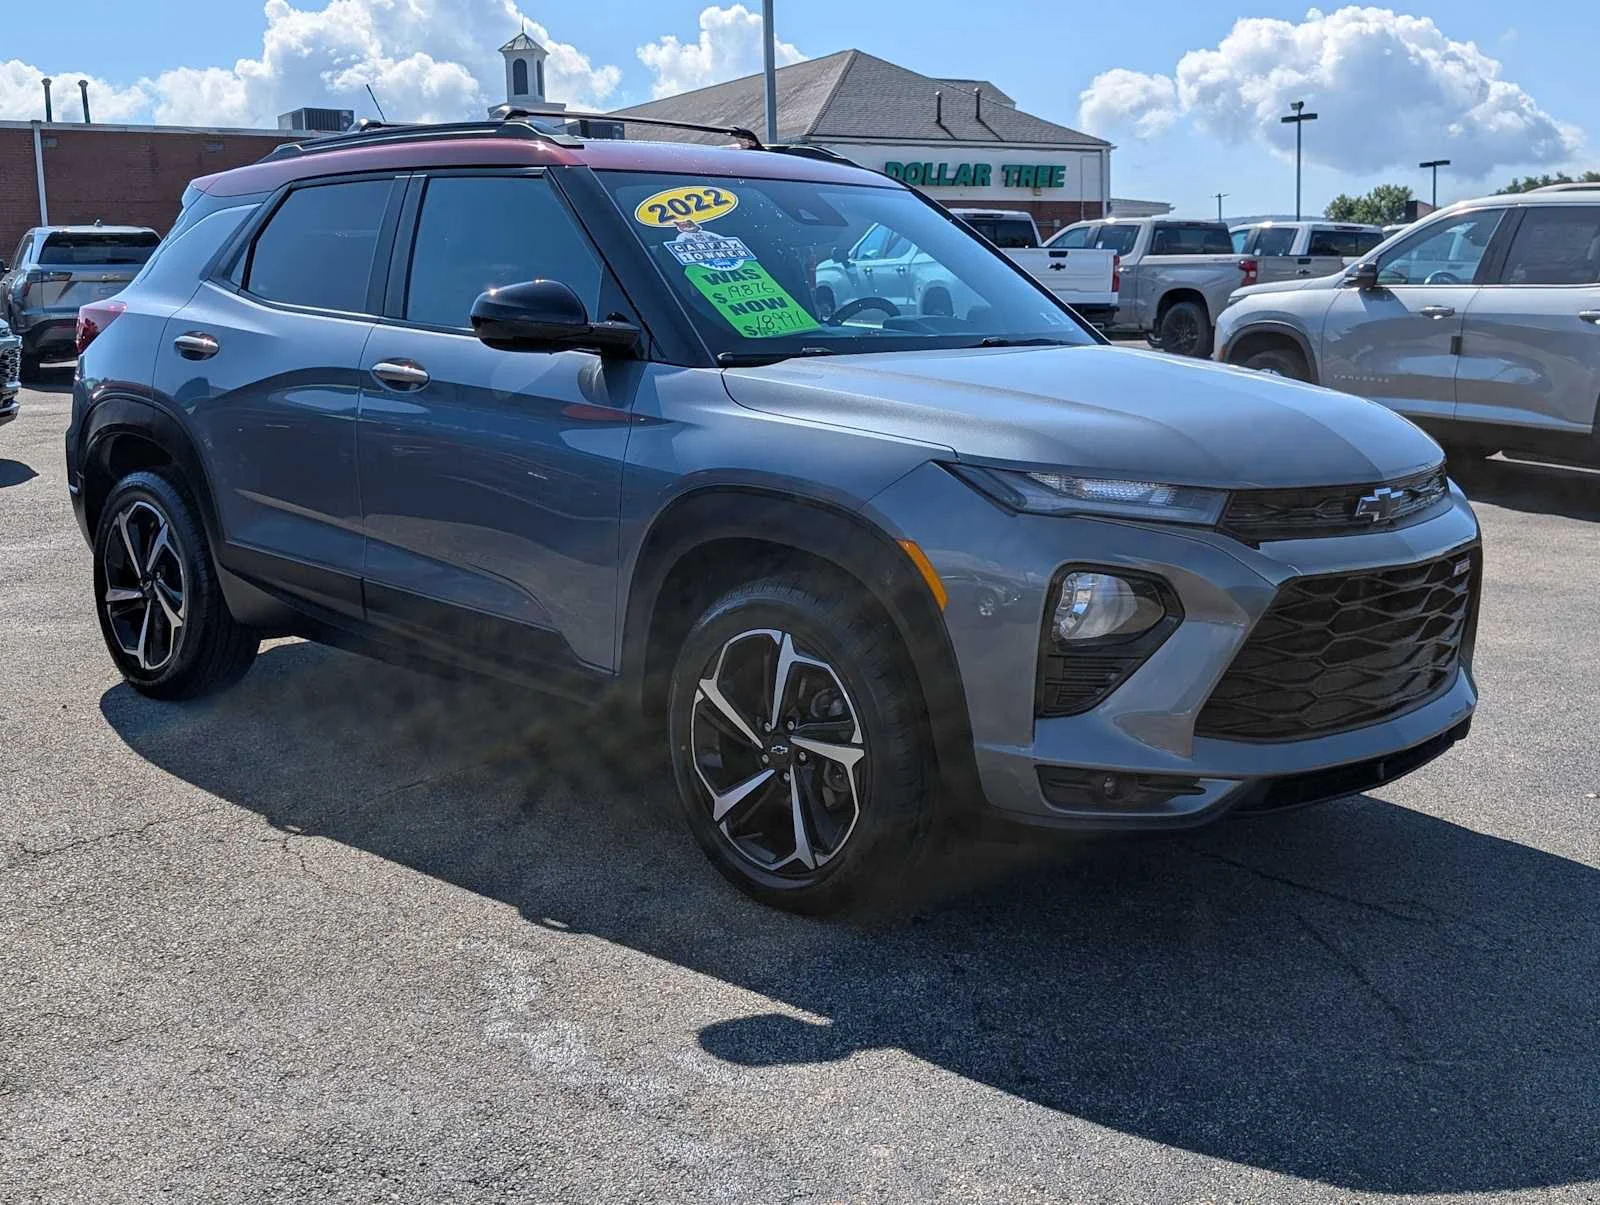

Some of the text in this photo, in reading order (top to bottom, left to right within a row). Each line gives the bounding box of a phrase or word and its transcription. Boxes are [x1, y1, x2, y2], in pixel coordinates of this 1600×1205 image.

[885, 161, 1066, 188] DOLLAR TREE
[648, 189, 731, 223] 2022
[694, 250, 749, 260] OWNER
[702, 268, 762, 286] WAS
[728, 297, 789, 316] NOW
